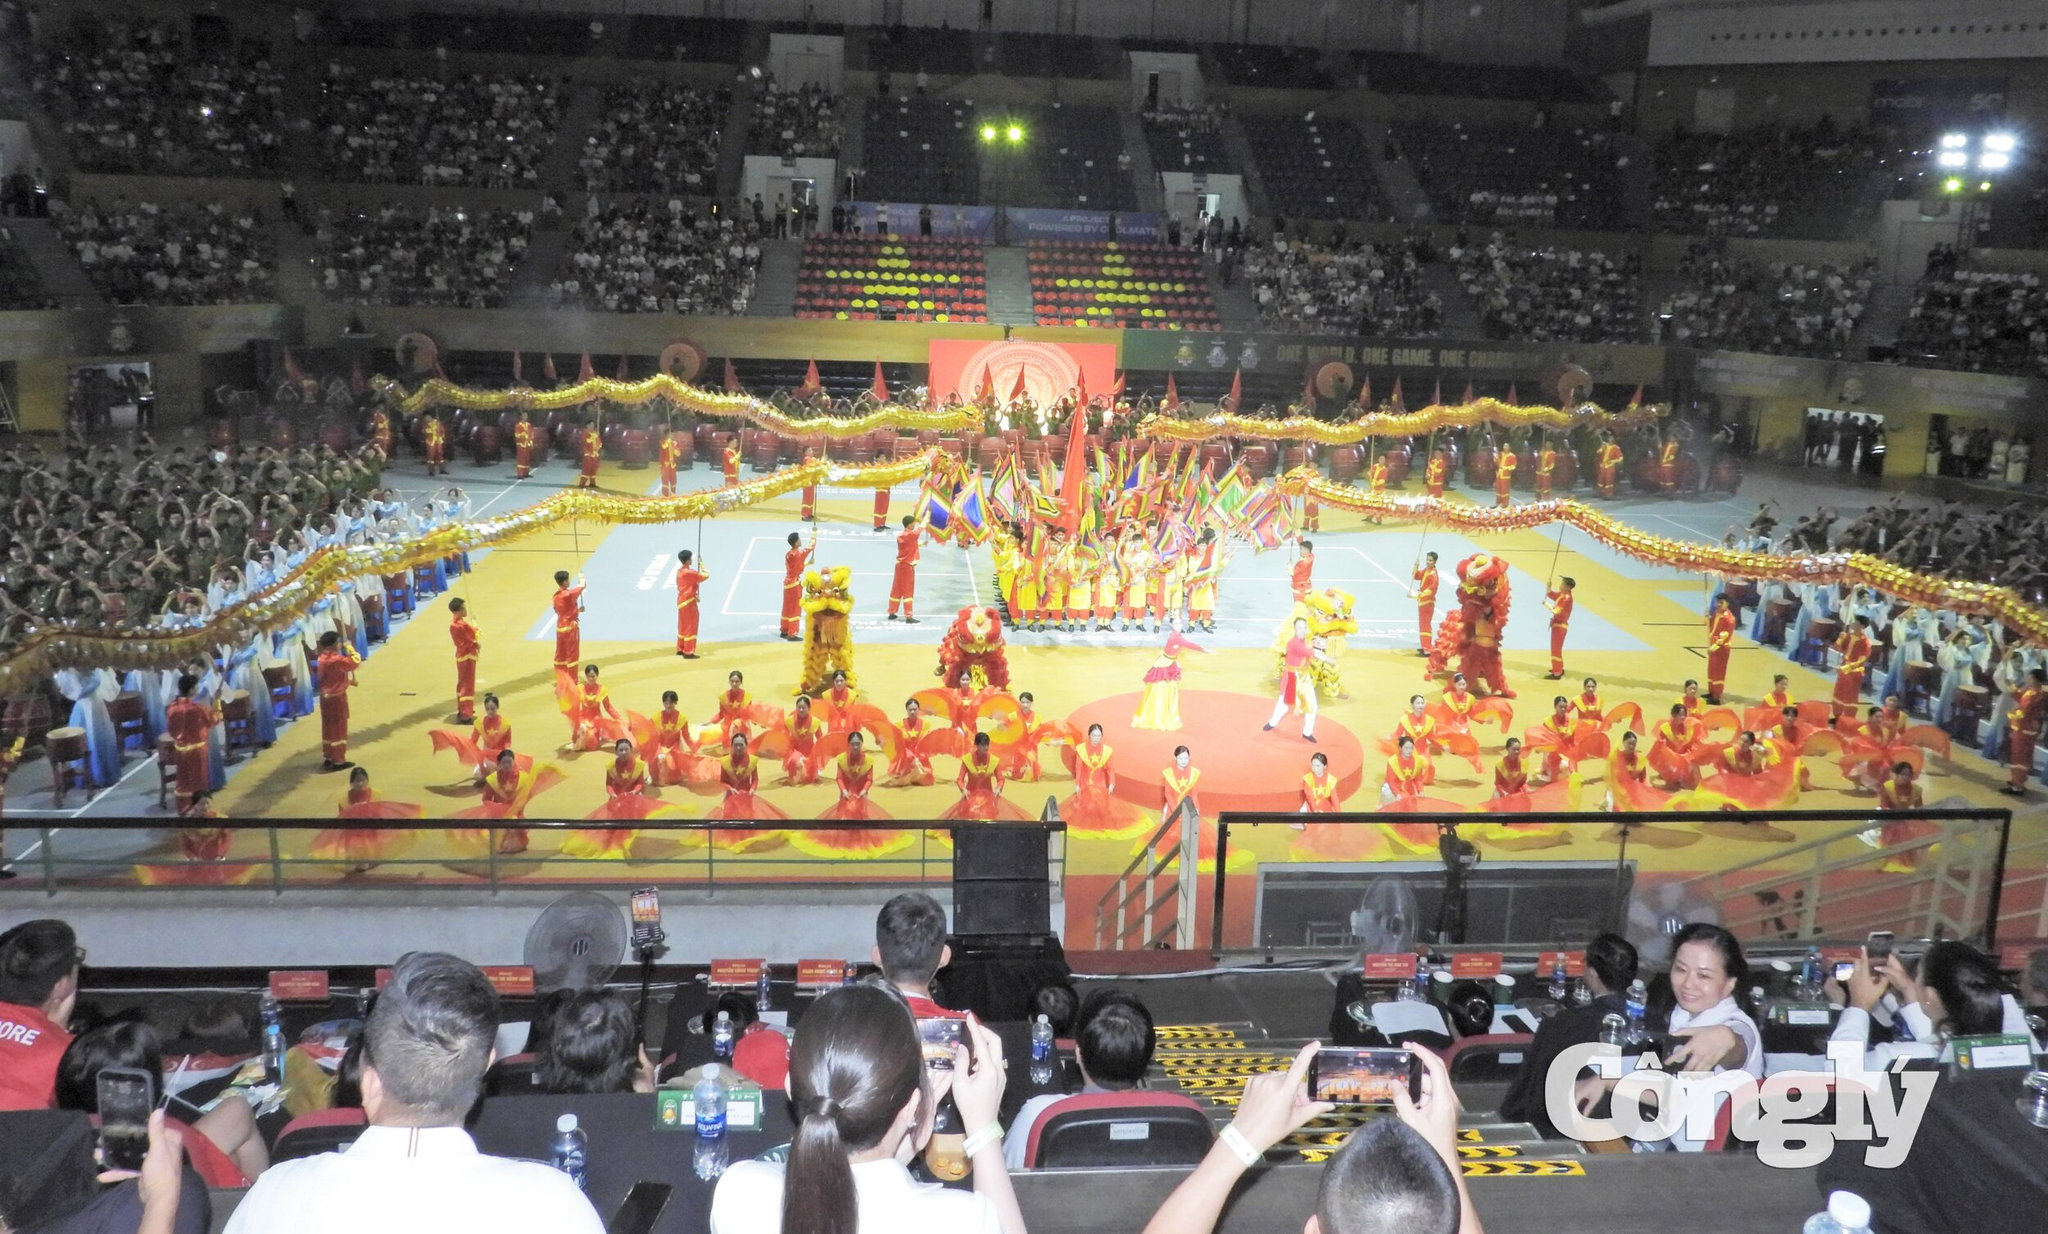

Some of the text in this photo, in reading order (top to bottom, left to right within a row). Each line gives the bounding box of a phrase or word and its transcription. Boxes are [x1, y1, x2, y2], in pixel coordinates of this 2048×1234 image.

[1028, 222, 1158, 236] POWERED BY COLMATE
[1276, 345, 1303, 362] ONE
[1362, 347, 1389, 365] ONE
[1392, 348, 1435, 367] GAME.
[1439, 350, 1465, 368] ONE
[0, 1019, 41, 1046] ORE
